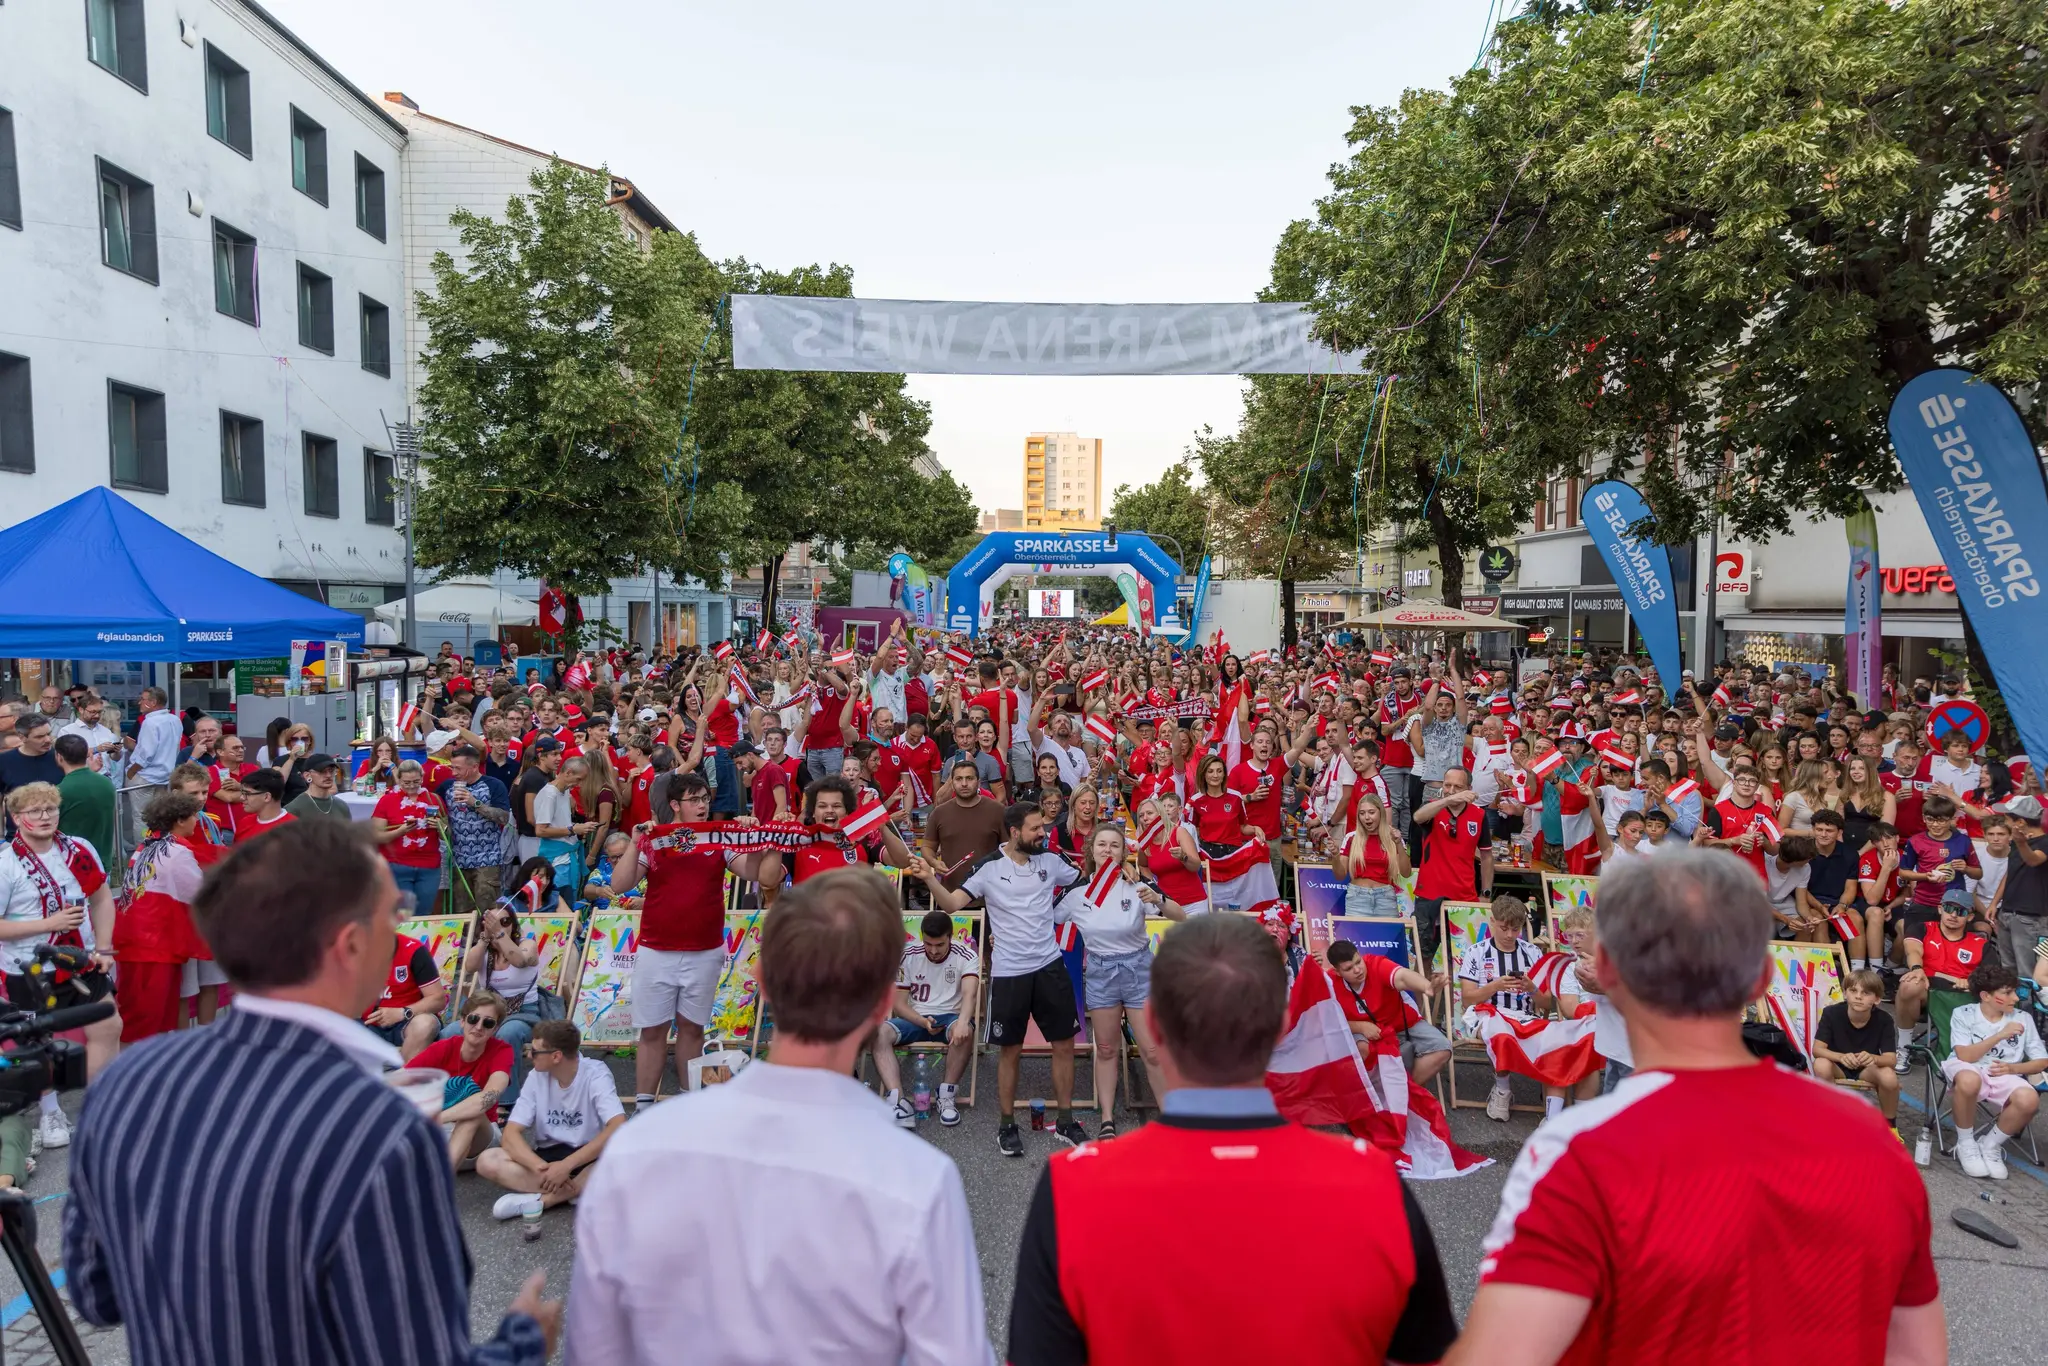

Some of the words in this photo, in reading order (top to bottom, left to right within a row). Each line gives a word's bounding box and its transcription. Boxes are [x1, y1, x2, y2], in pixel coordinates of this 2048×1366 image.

[1014, 540, 1101, 552] SPARKASSE
[963, 547, 997, 578] #glaubandich
[1014, 553, 1077, 561] Oberösterreich
[1136, 547, 1170, 578] #glaubandich
[1404, 568, 1432, 587] TRAFIK
[1307, 598, 1330, 606] Thalia
[1504, 599, 1515, 609] HIGH
[1516, 598, 1536, 609] QUALITY
[1536, 598, 1547, 609] CBD
[1547, 598, 1564, 609] STORE
[1574, 599, 1601, 610] CANNABIS
[1603, 599, 1624, 610] STORE
[97, 632, 164, 642] #glaubandich
[187, 631, 226, 642] SPARKASSE
[292, 642, 308, 650] Red
[1360, 940, 1399, 949] LIWEST
[911, 982, 931, 1003] 20
